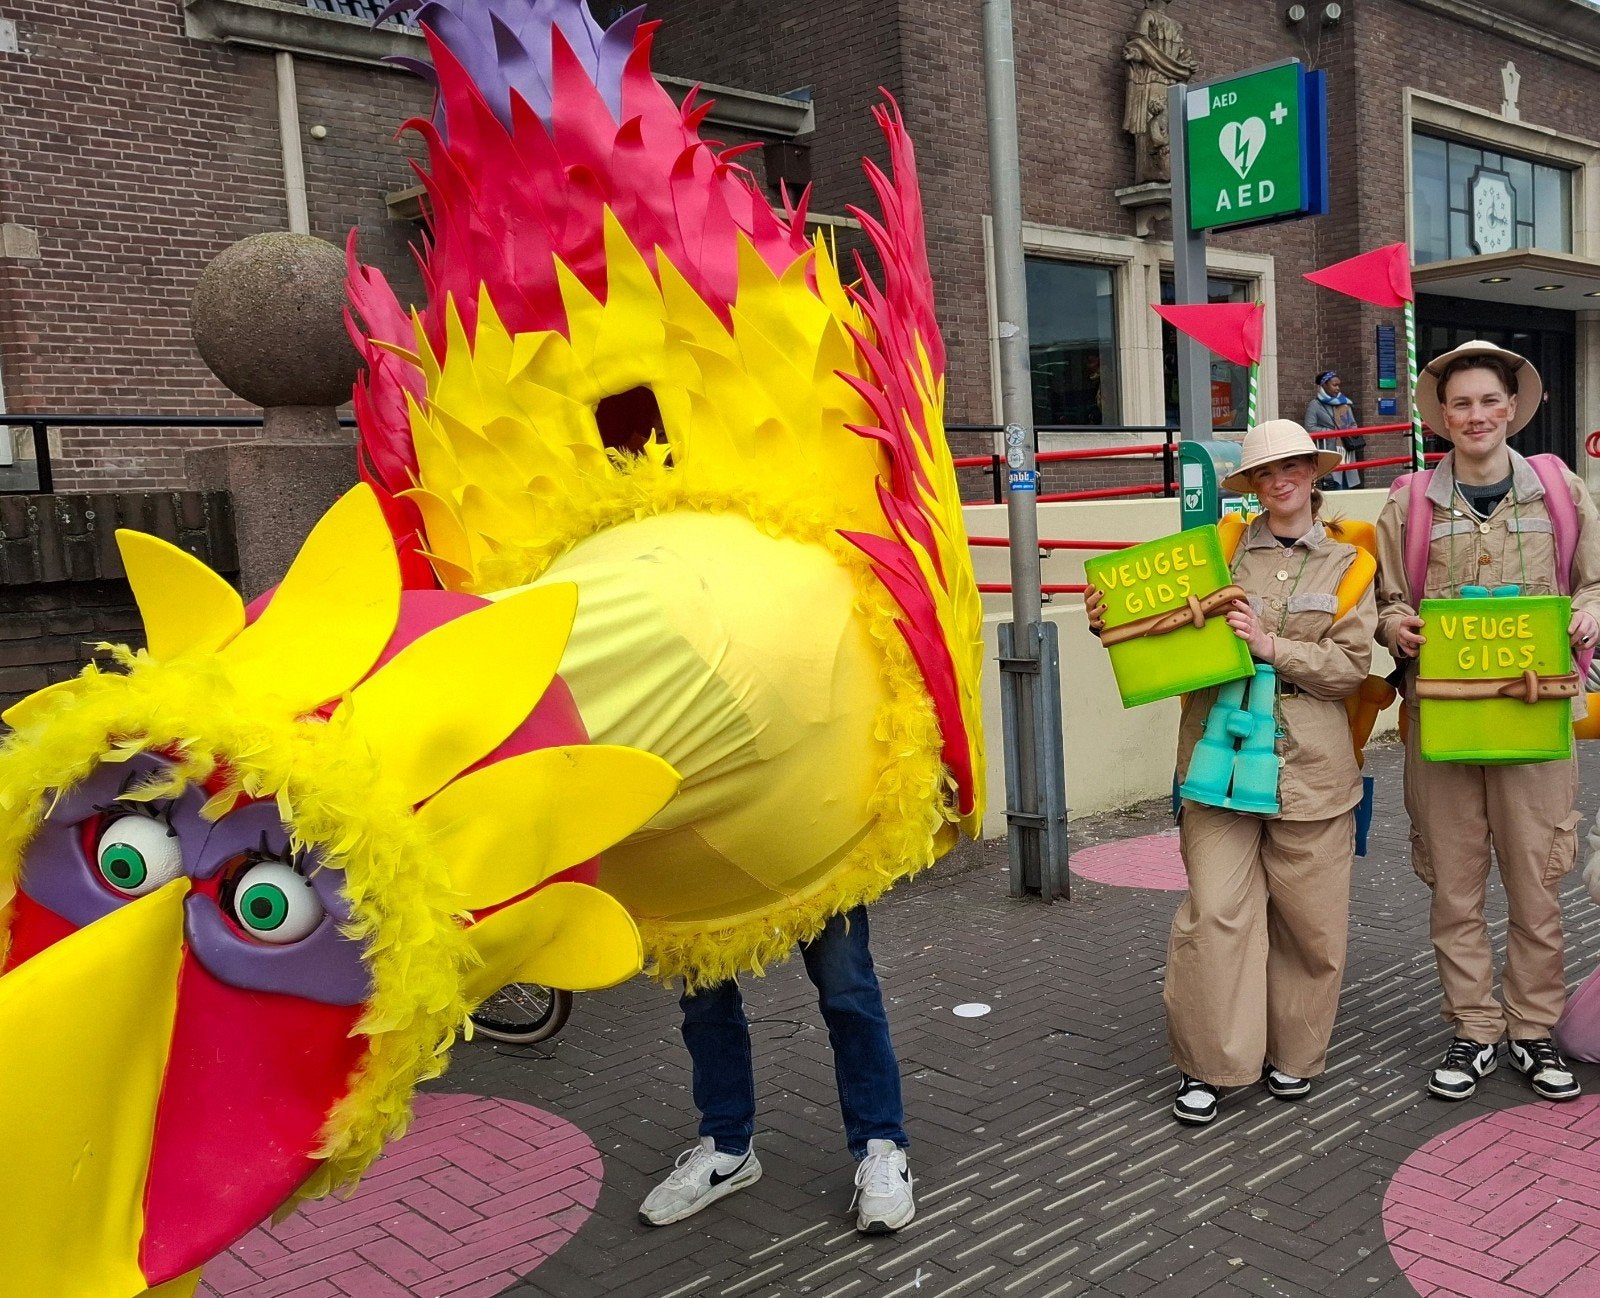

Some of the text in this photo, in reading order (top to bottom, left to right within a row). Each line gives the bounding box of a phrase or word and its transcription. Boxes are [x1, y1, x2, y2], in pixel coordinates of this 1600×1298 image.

[1212, 92, 1237, 110] AED
[1215, 180, 1275, 212] AED
[1099, 544, 1207, 590] VEUGEL
[1125, 574, 1191, 614] GIDS
[1440, 614, 1533, 640] VEUGE
[1458, 644, 1536, 672] GIDS
